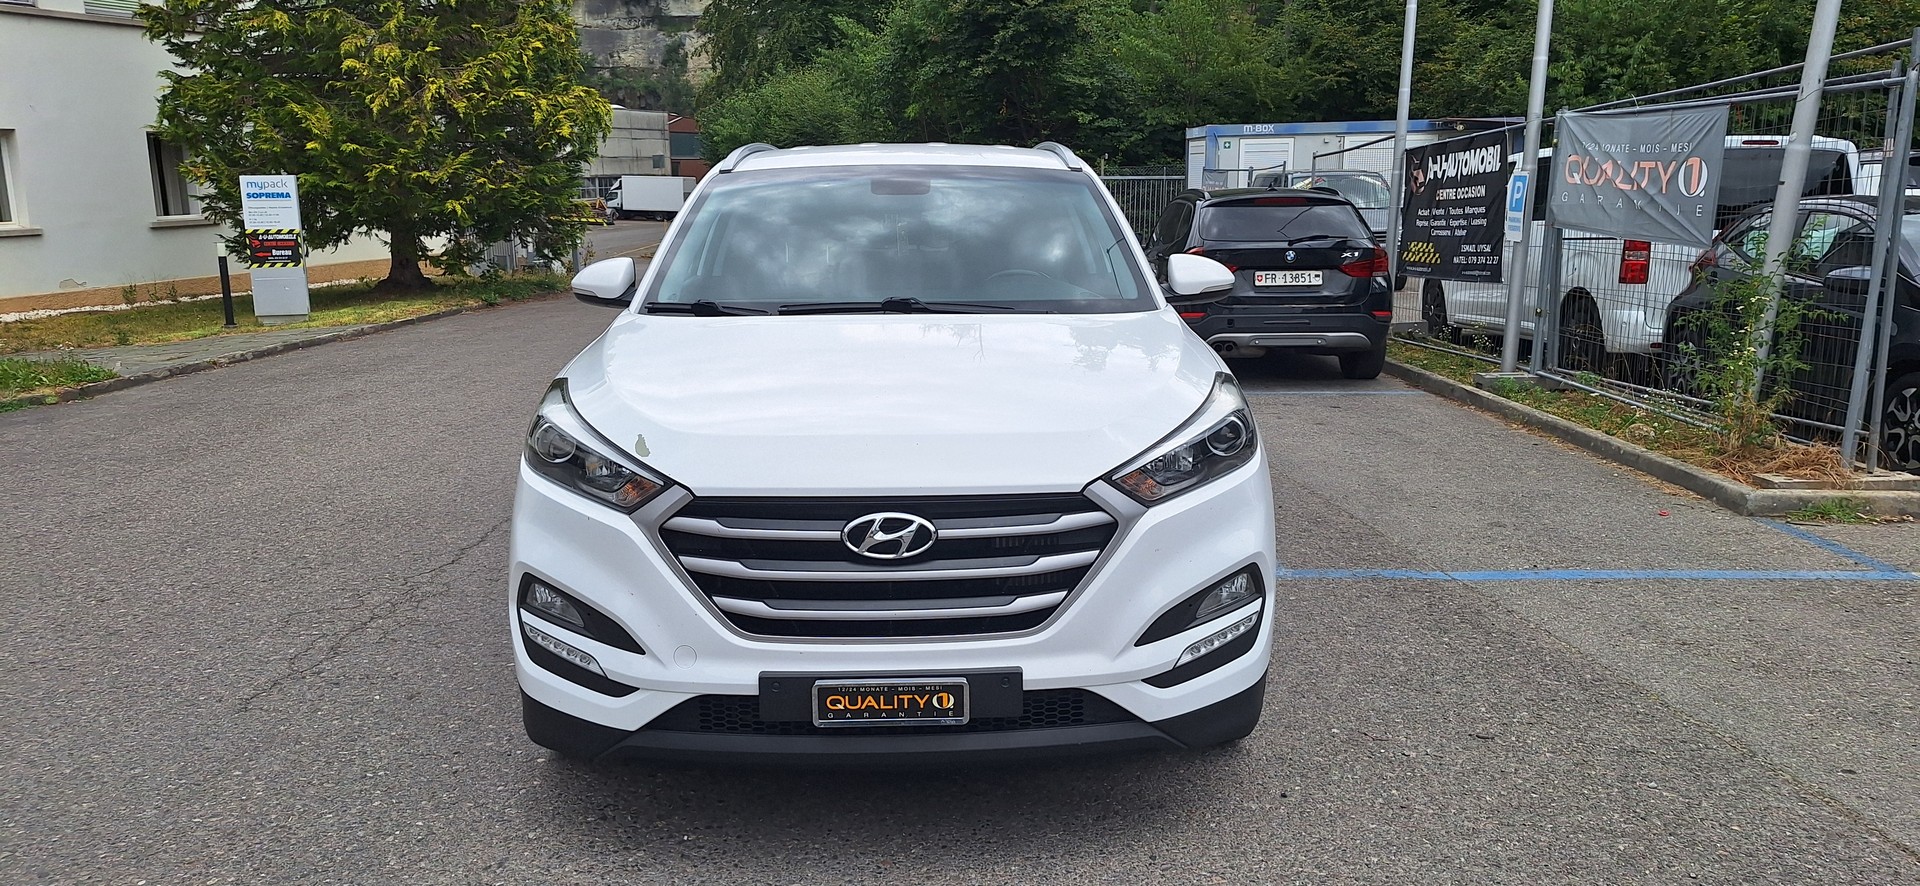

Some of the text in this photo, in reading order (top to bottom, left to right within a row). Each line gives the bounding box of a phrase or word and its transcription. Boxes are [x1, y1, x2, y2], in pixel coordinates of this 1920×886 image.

[1640, 144, 1660, 153] MOIS
[1671, 142, 1692, 152] MESI
[1565, 154, 1677, 194] QUALITY
[246, 178, 288, 190] mypack
[1436, 185, 1486, 200] CENTRE OCCASION
[1512, 182, 1524, 207] P
[1449, 207, 1463, 215] Toutes
[1464, 206, 1486, 215] Marques
[1471, 217, 1487, 226] Leasing
[1461, 244, 1492, 252] ISMAIL UYSAL
[1453, 256, 1467, 264] NATEL:
[1264, 273, 1277, 283] FR
[826, 694, 930, 710] QUALITY
[828, 710, 954, 718] GARANTIE
